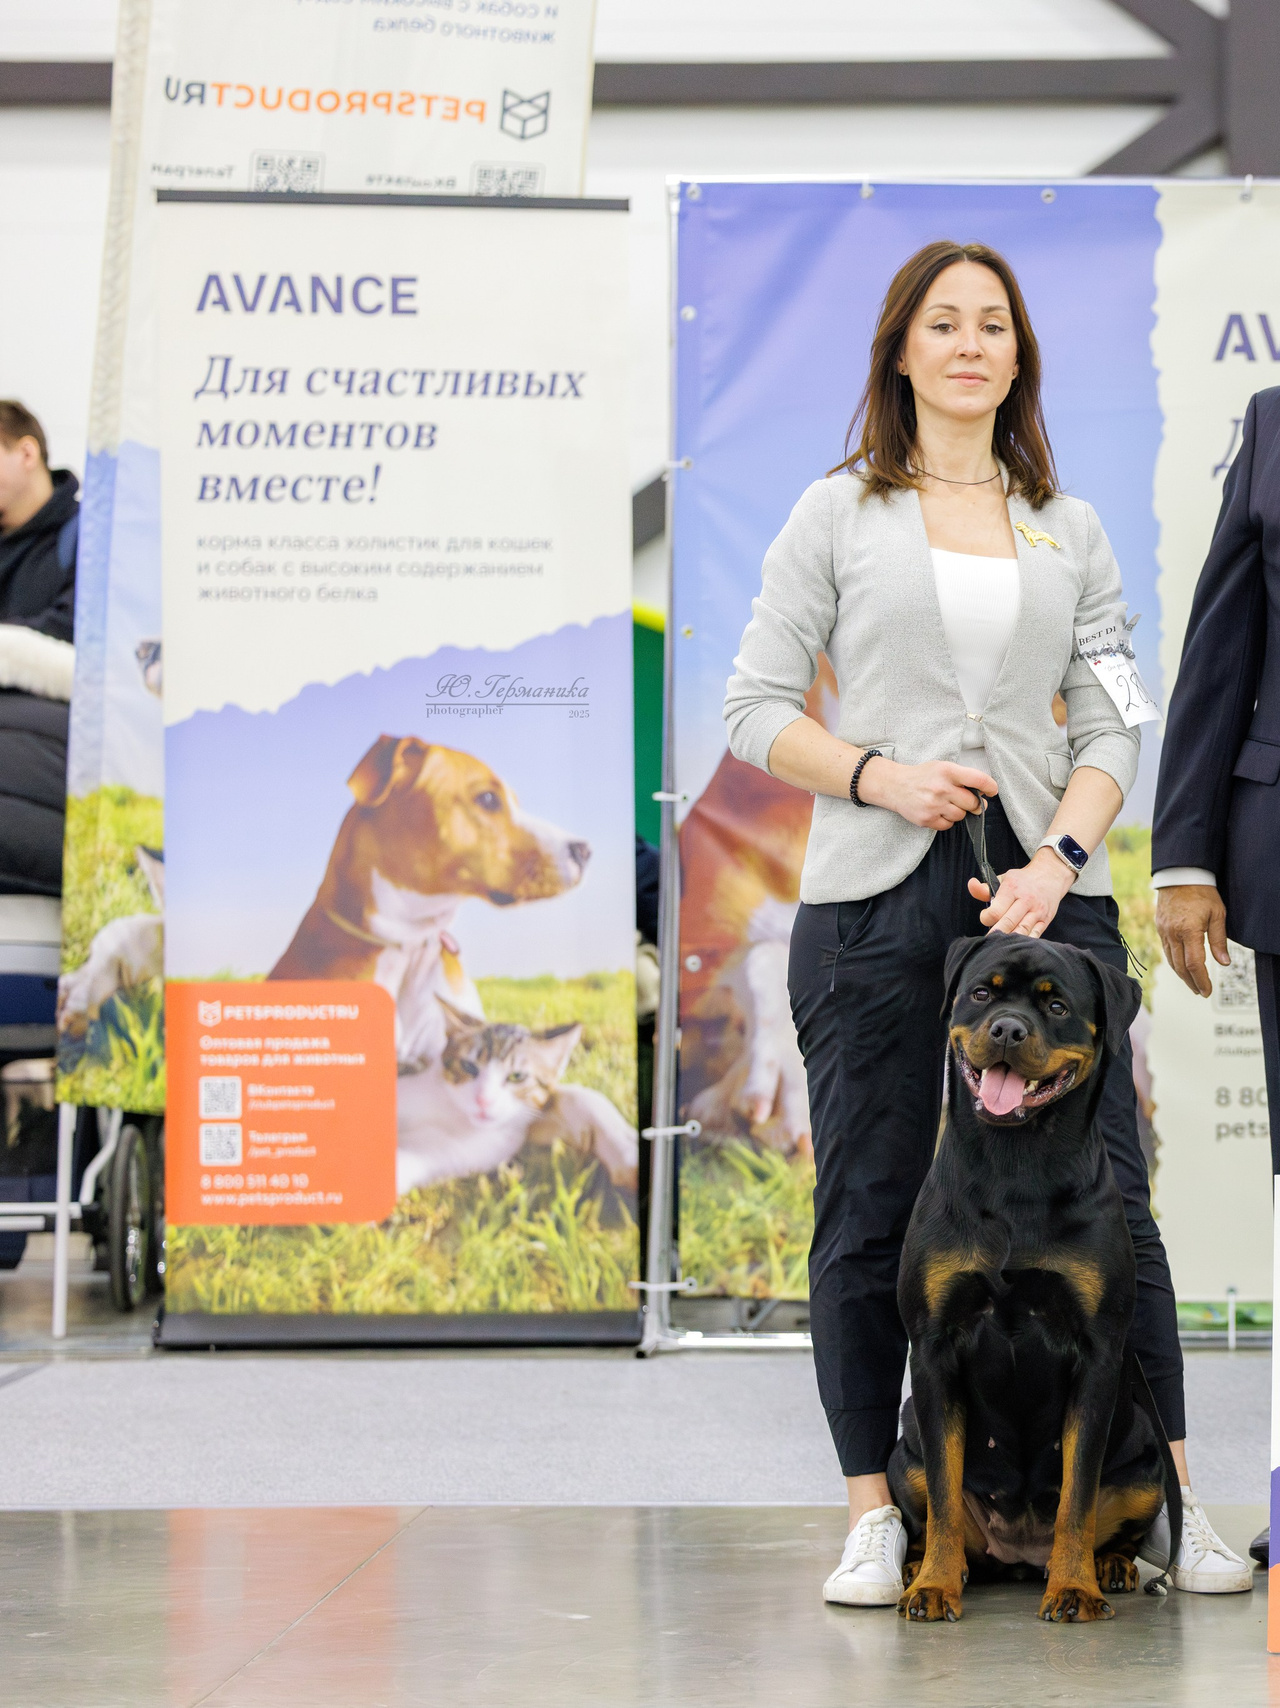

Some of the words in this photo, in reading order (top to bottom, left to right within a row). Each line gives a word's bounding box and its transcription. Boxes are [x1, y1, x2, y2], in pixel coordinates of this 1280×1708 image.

[196, 273, 419, 315] AVANCE
[193, 355, 290, 401] Для
[305, 364, 587, 399] счастливых
[196, 418, 440, 449] моментов
[195, 462, 383, 504] вместе!
[1215, 1086, 1231, 1108] 8
